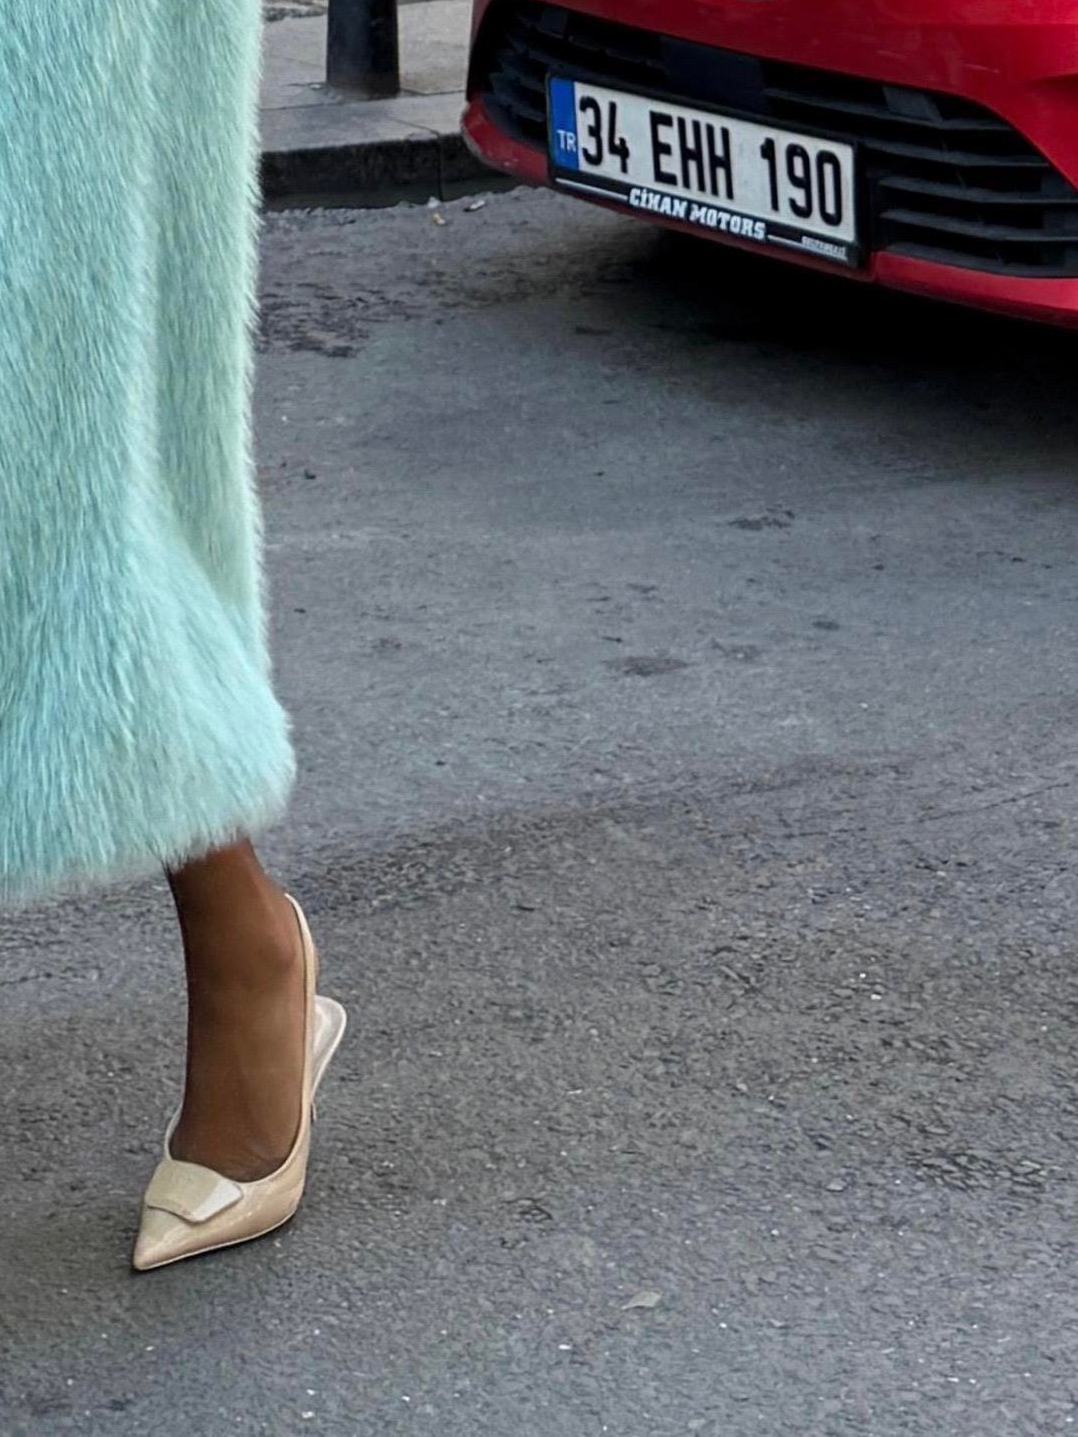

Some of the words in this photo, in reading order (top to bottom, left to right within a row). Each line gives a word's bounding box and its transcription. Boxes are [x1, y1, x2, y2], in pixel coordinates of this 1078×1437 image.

[556, 128, 577, 153] TR
[578, 95, 630, 175] 34
[648, 109, 734, 200] EHH
[760, 137, 843, 227] 190
[689, 203, 768, 241] MOTORS
